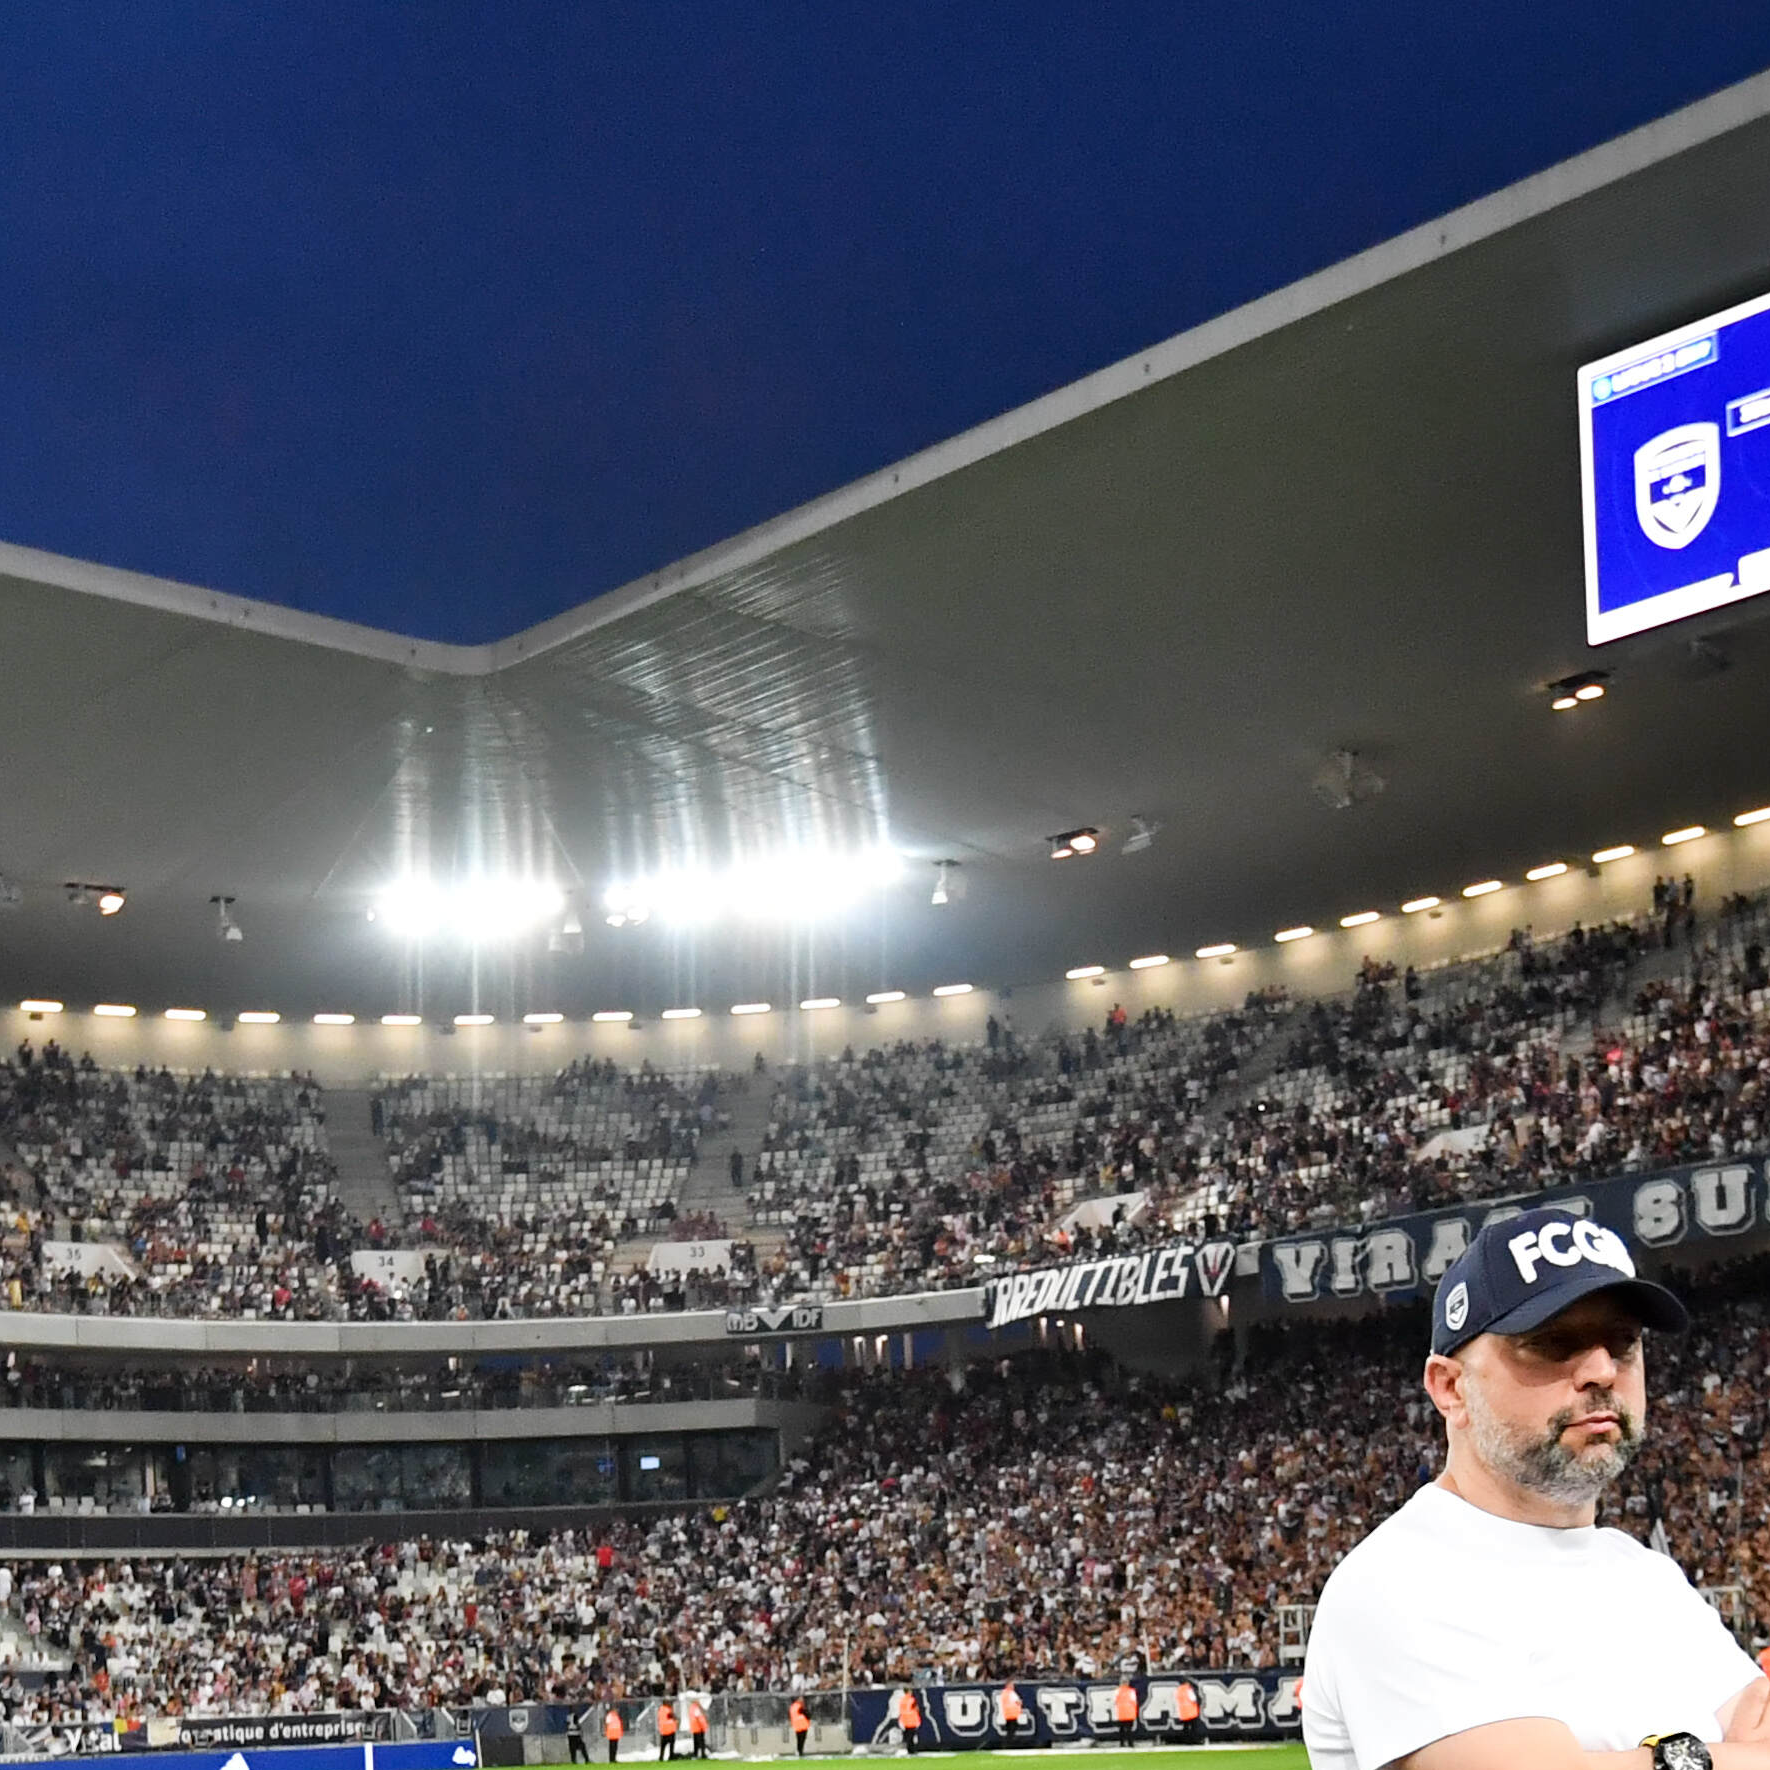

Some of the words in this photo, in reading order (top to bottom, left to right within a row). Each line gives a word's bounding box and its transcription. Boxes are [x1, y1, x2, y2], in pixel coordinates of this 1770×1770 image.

[689, 1245, 706, 1258] 33
[1272, 1194, 1593, 1304] VIRA
[378, 1255, 395, 1268] 34
[792, 1307, 823, 1328] IDF
